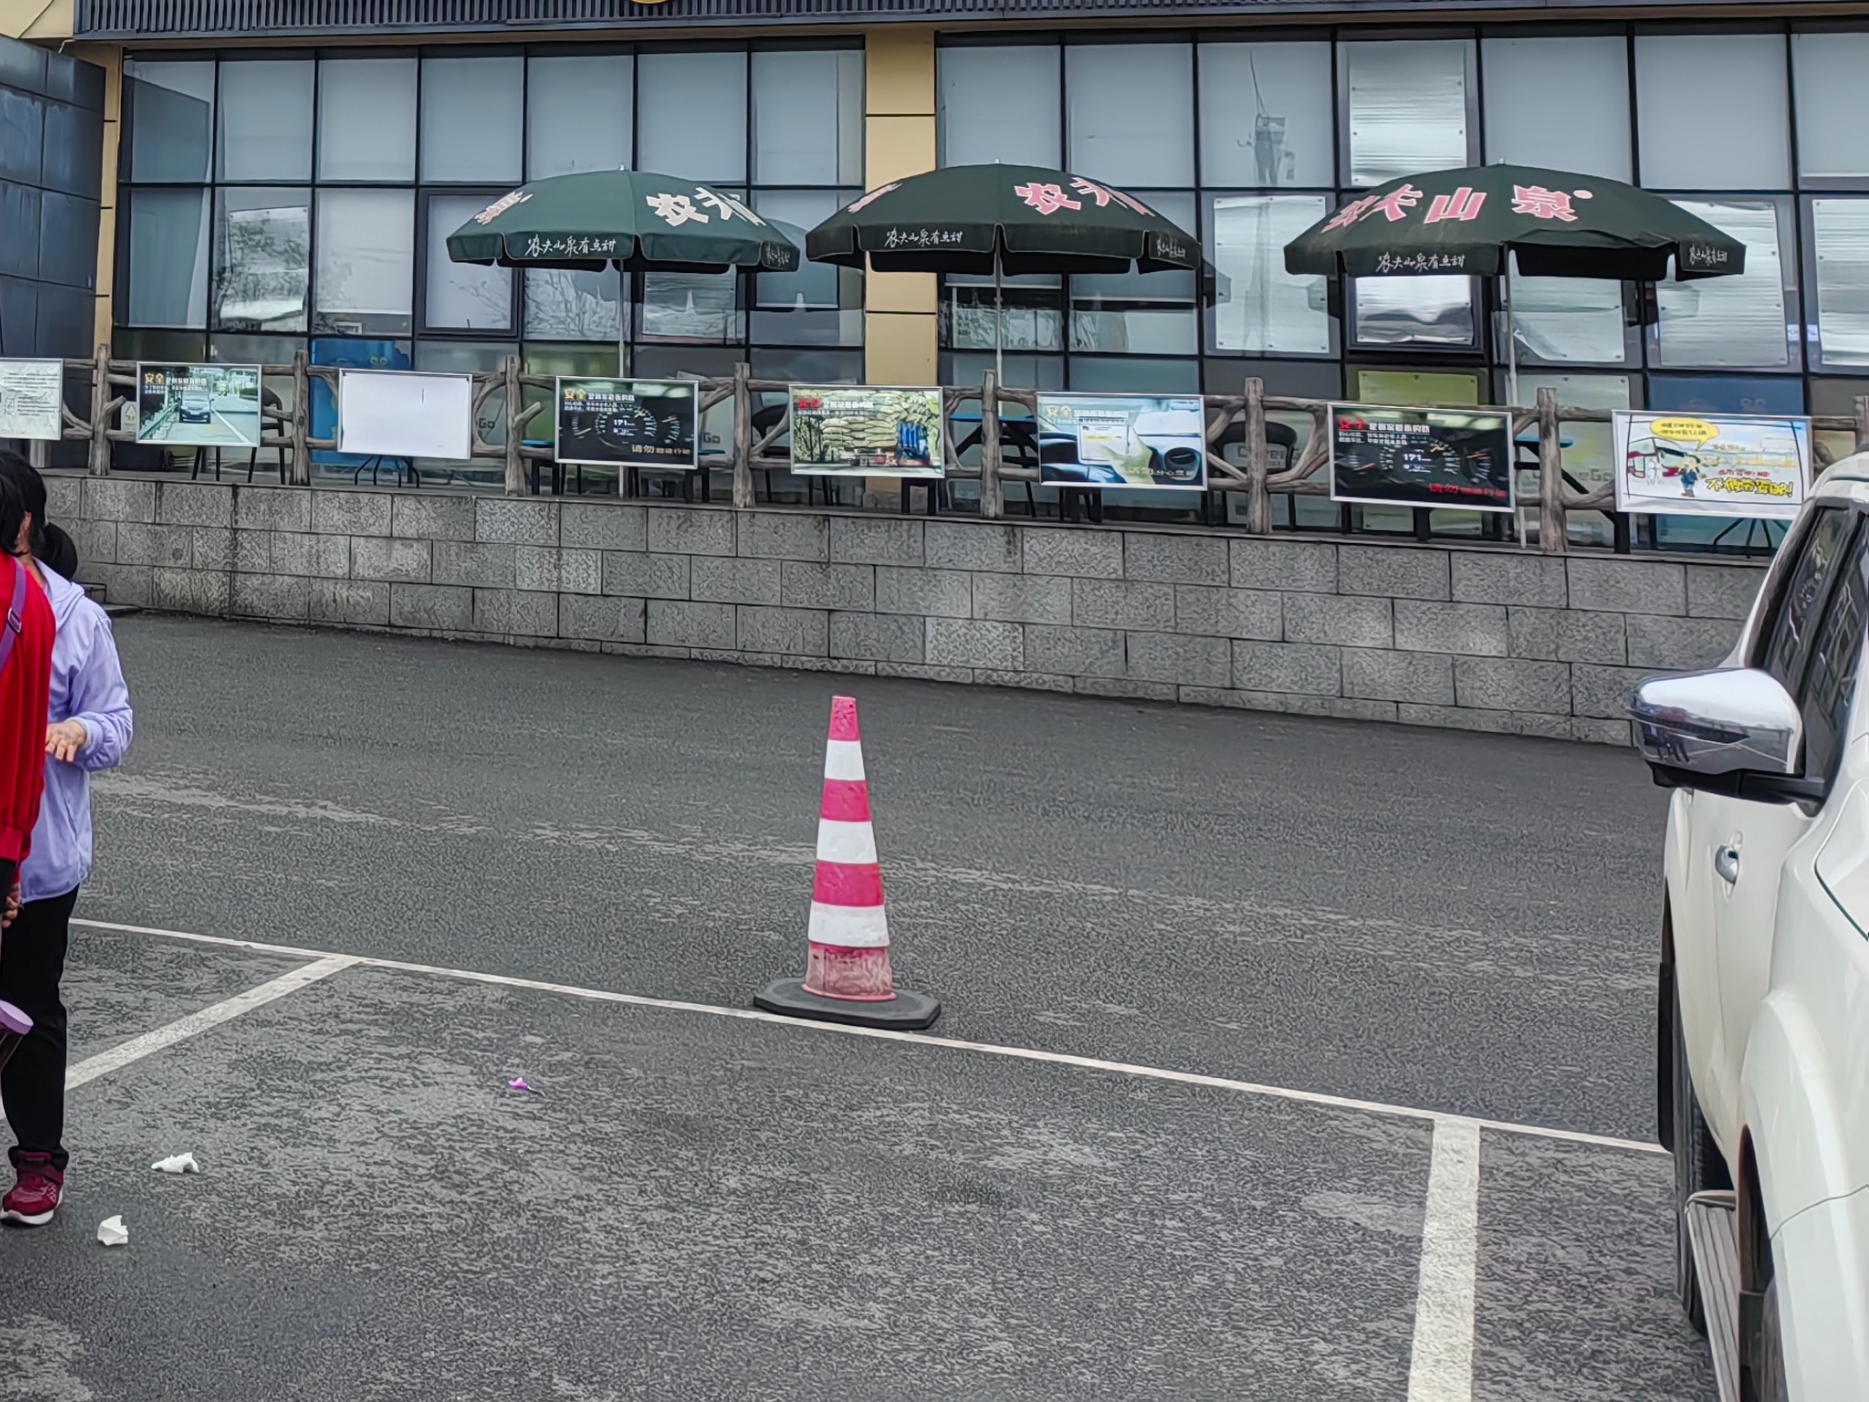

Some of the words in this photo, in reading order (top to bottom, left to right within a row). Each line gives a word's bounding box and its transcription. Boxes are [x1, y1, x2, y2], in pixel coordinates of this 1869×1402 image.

[525, 233, 617, 258] 农夫山泉有点甜
[884, 228, 964, 249] 农夫山泉有点甜
[1375, 251, 1466, 274] 农夫山泉有点甜
